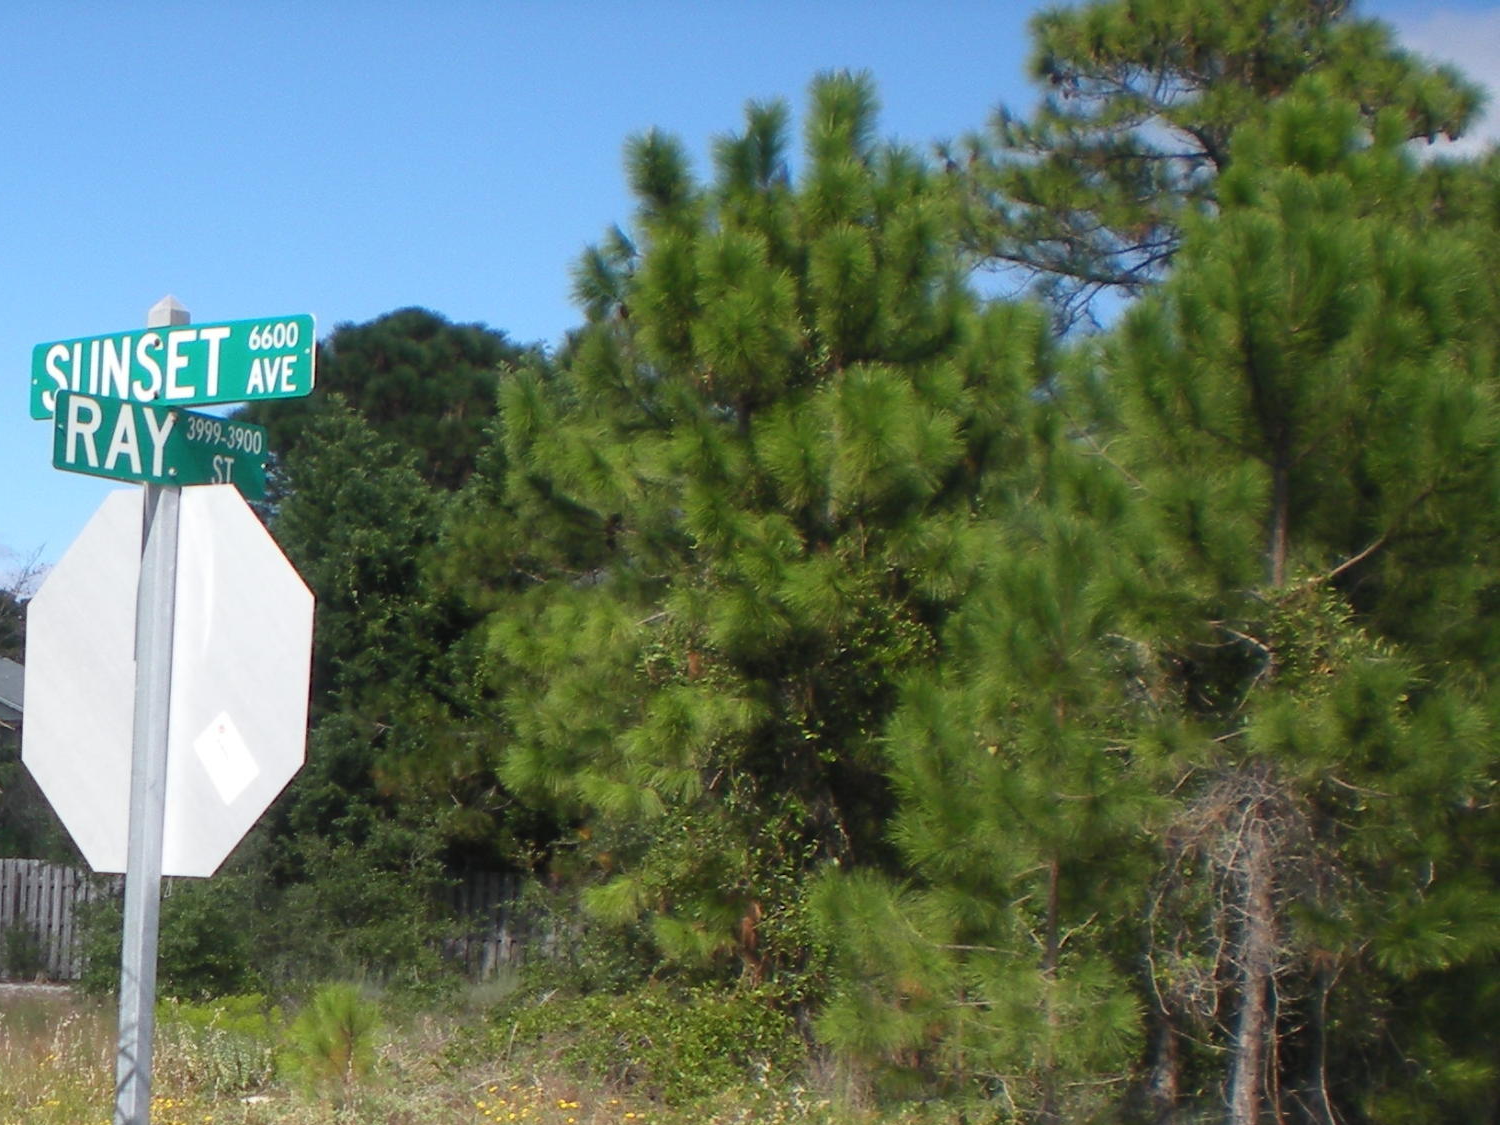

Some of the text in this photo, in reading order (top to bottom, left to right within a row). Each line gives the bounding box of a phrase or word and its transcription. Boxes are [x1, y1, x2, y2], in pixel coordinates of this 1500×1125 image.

[248, 321, 299, 351] 6600
[41, 326, 298, 413] SUNSET AVE
[64, 395, 179, 478] RAY
[186, 416, 263, 455] 3999-3900
[211, 453, 235, 485] ST
